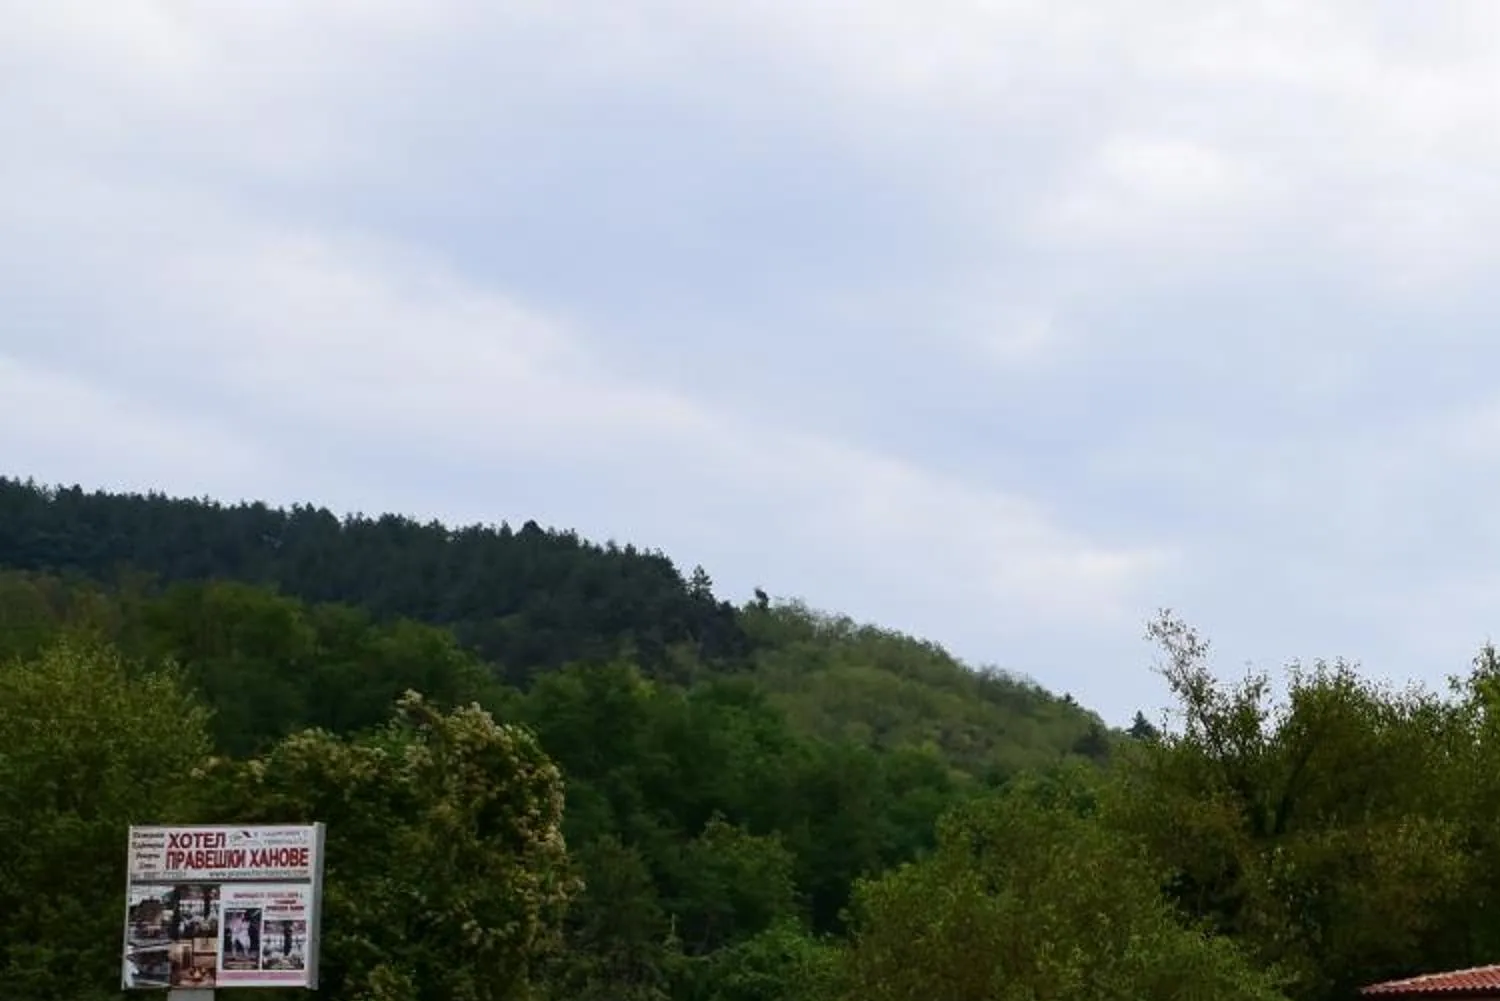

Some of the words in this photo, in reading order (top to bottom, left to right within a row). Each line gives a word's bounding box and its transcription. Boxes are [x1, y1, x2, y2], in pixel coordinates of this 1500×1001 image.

[168, 831, 226, 849] ХОТЕЛ
[165, 849, 246, 870] ПРАВЕШКИ
[250, 847, 309, 868] ХАНОВЕ
